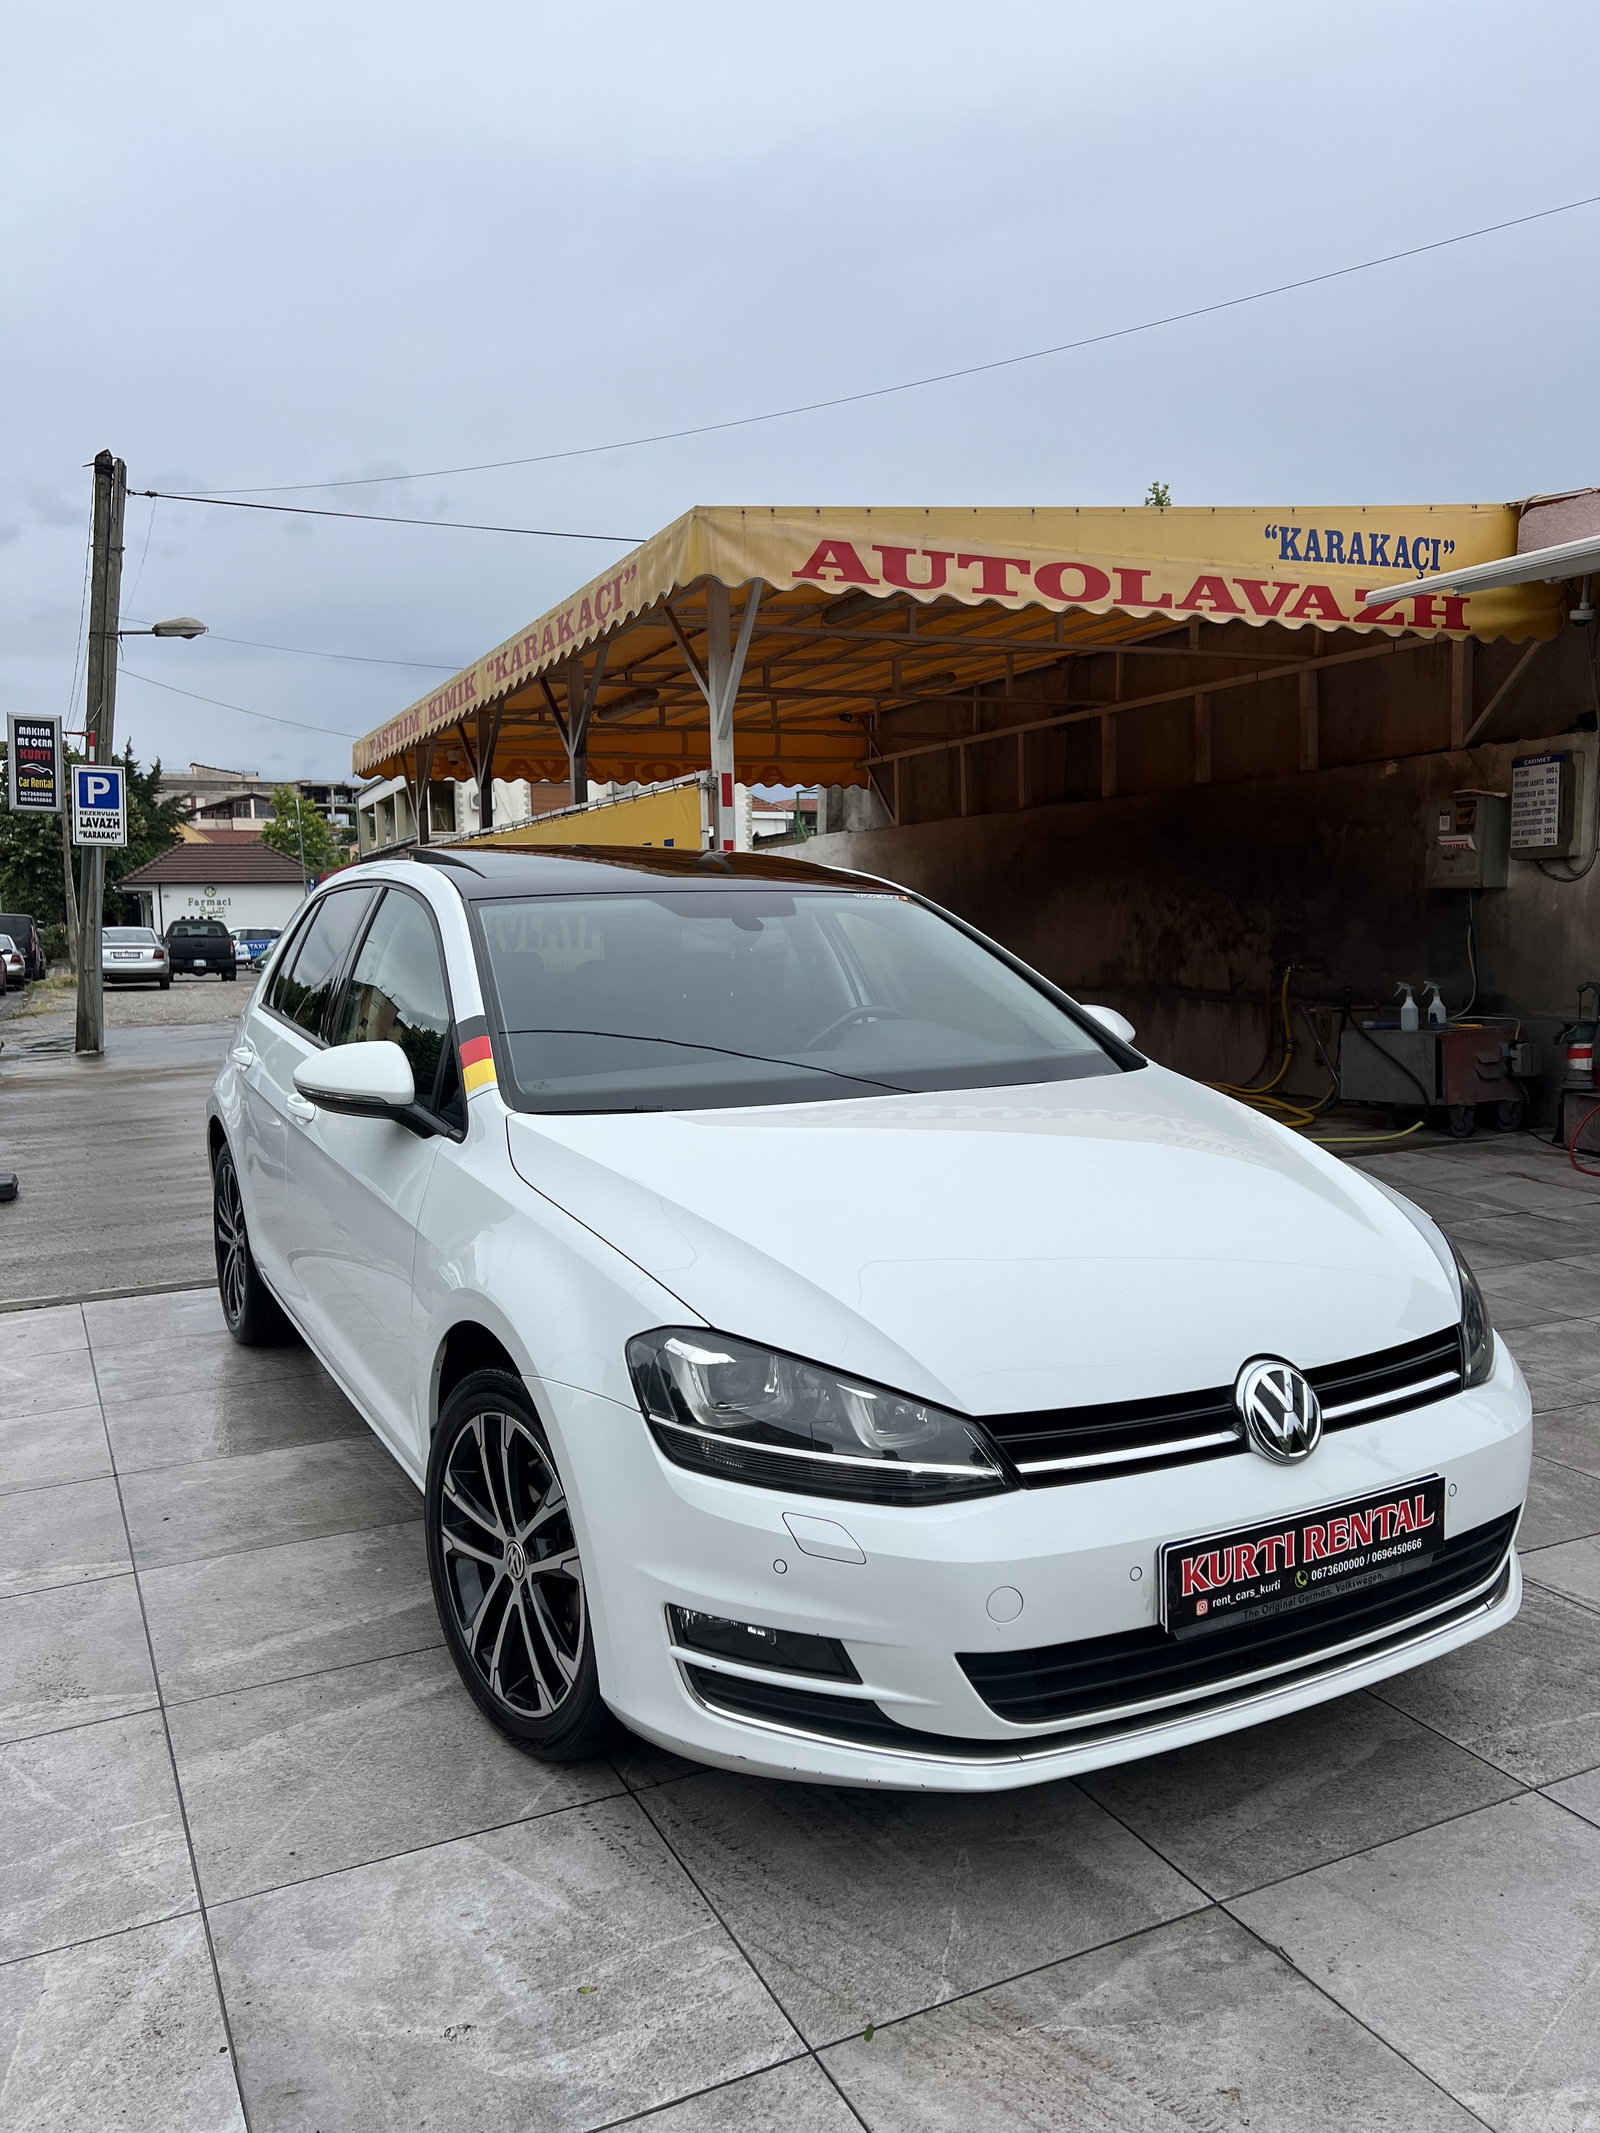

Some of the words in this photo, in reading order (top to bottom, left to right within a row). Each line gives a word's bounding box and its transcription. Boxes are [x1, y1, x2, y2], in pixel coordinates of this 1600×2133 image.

[793, 540, 1472, 631] AUTOLAVAZH
[369, 709, 421, 758] PASTRIM
[428, 671, 477, 723] KIMIK
[17, 737, 29, 746] ME
[20, 749, 50, 760] KURTI
[18, 777, 29, 787] Car
[31, 777, 53, 788] Rental
[87, 776, 110, 804] P
[80, 817, 120, 829] LAVAZH
[1181, 1530, 1296, 1597] KURTI
[1303, 1494, 1435, 1564] RENTAL
[1212, 1579, 1281, 1608] rent_cars_kurti
[1311, 1556, 1365, 1581] 0673600000
[1371, 1538, 1422, 1562] 0696450666
[1261, 1598, 1297, 1618] Original
